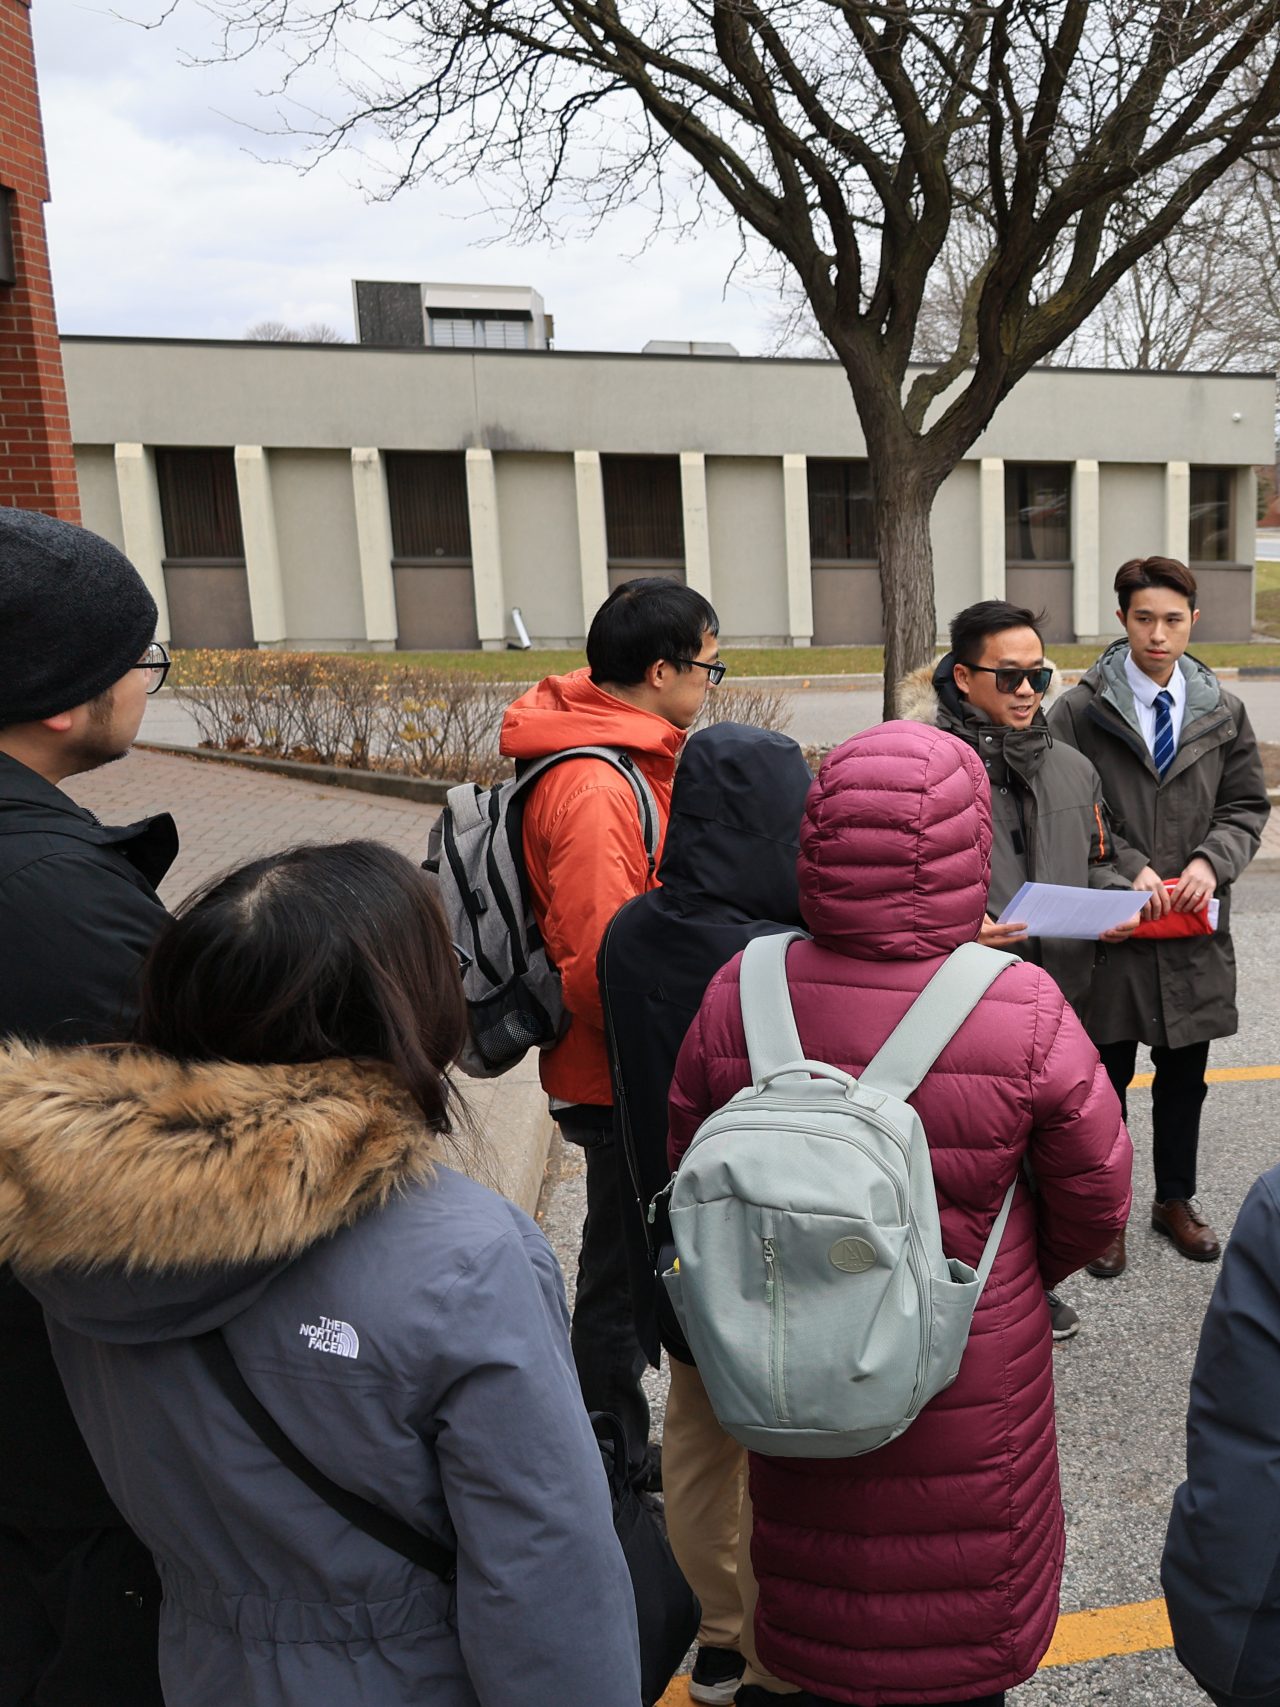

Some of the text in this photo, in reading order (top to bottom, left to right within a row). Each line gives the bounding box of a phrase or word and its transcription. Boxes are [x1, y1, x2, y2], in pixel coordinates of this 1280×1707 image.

[319, 1315, 341, 1331] THE
[299, 1323, 341, 1343] NORTH
[308, 1337, 338, 1353] FACE
